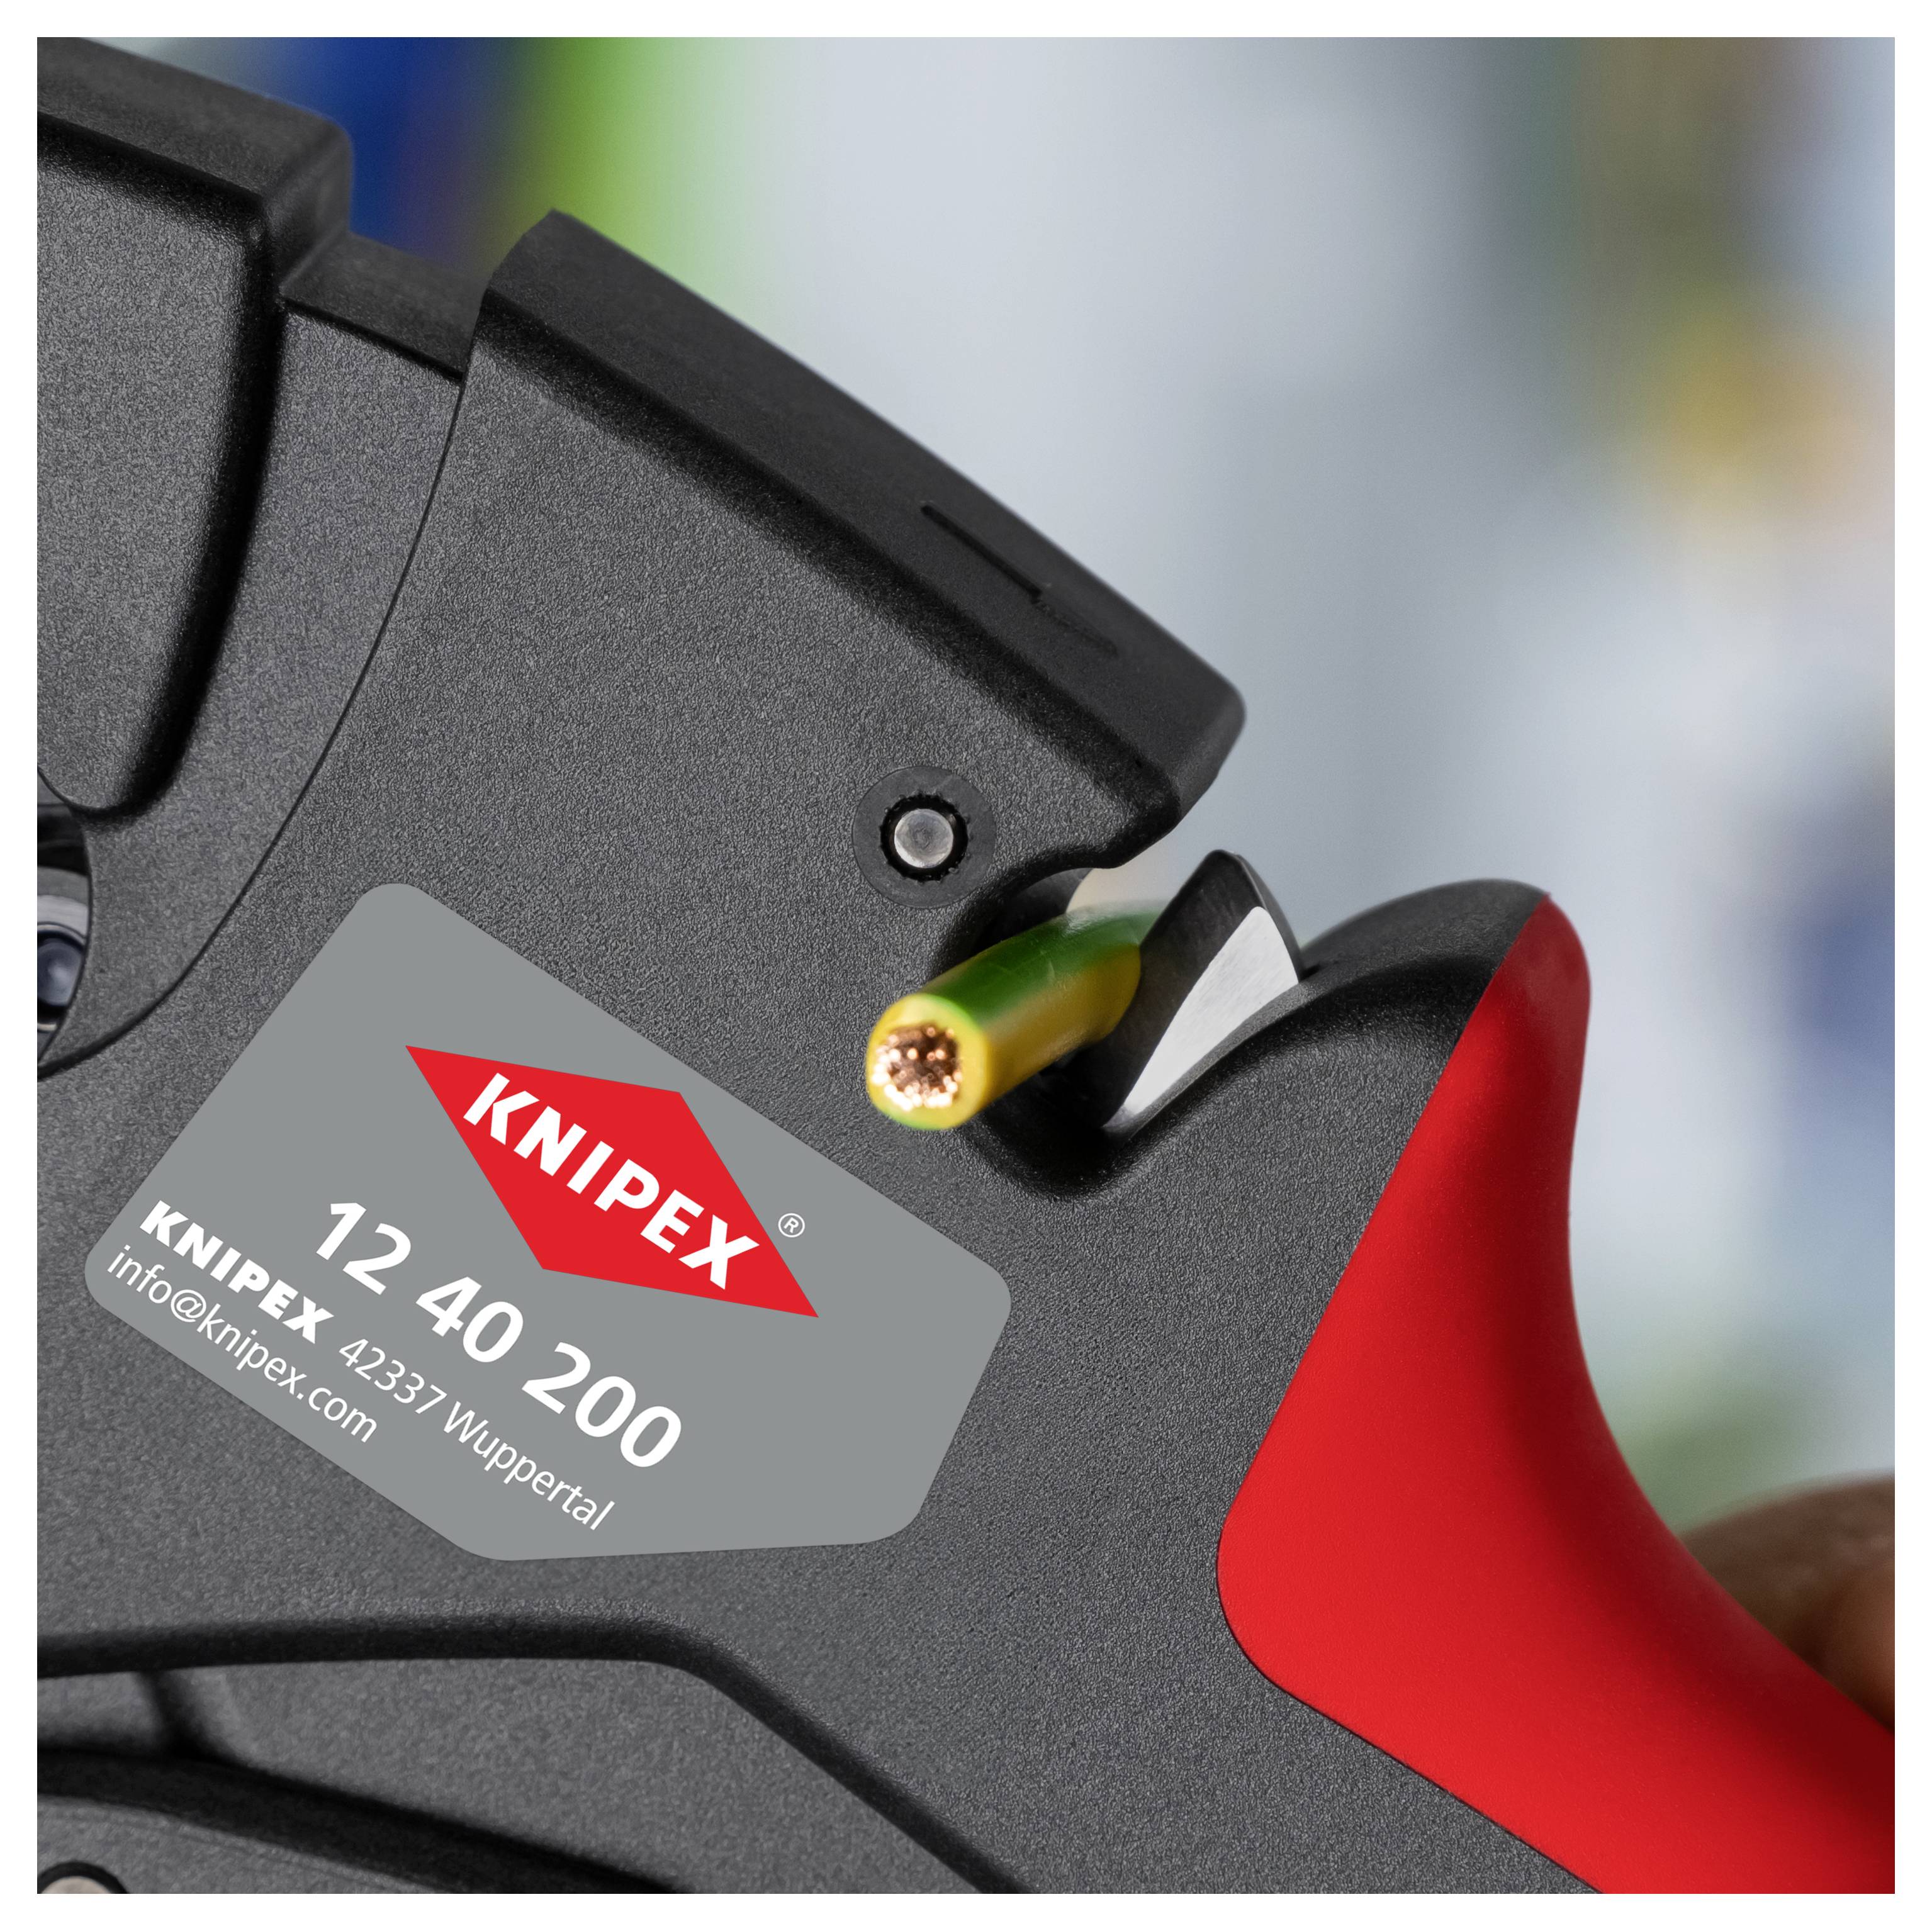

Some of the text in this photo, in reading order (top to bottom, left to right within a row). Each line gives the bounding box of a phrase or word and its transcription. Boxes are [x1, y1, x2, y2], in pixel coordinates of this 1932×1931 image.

[463, 1072, 760, 1290] KNIPEX
[106, 1244, 378, 1443] info@knipex.com
[138, 1199, 615, 1531] KNIPEX 42337 Wuppertal
[315, 1202, 682, 1468] 12 40 200
